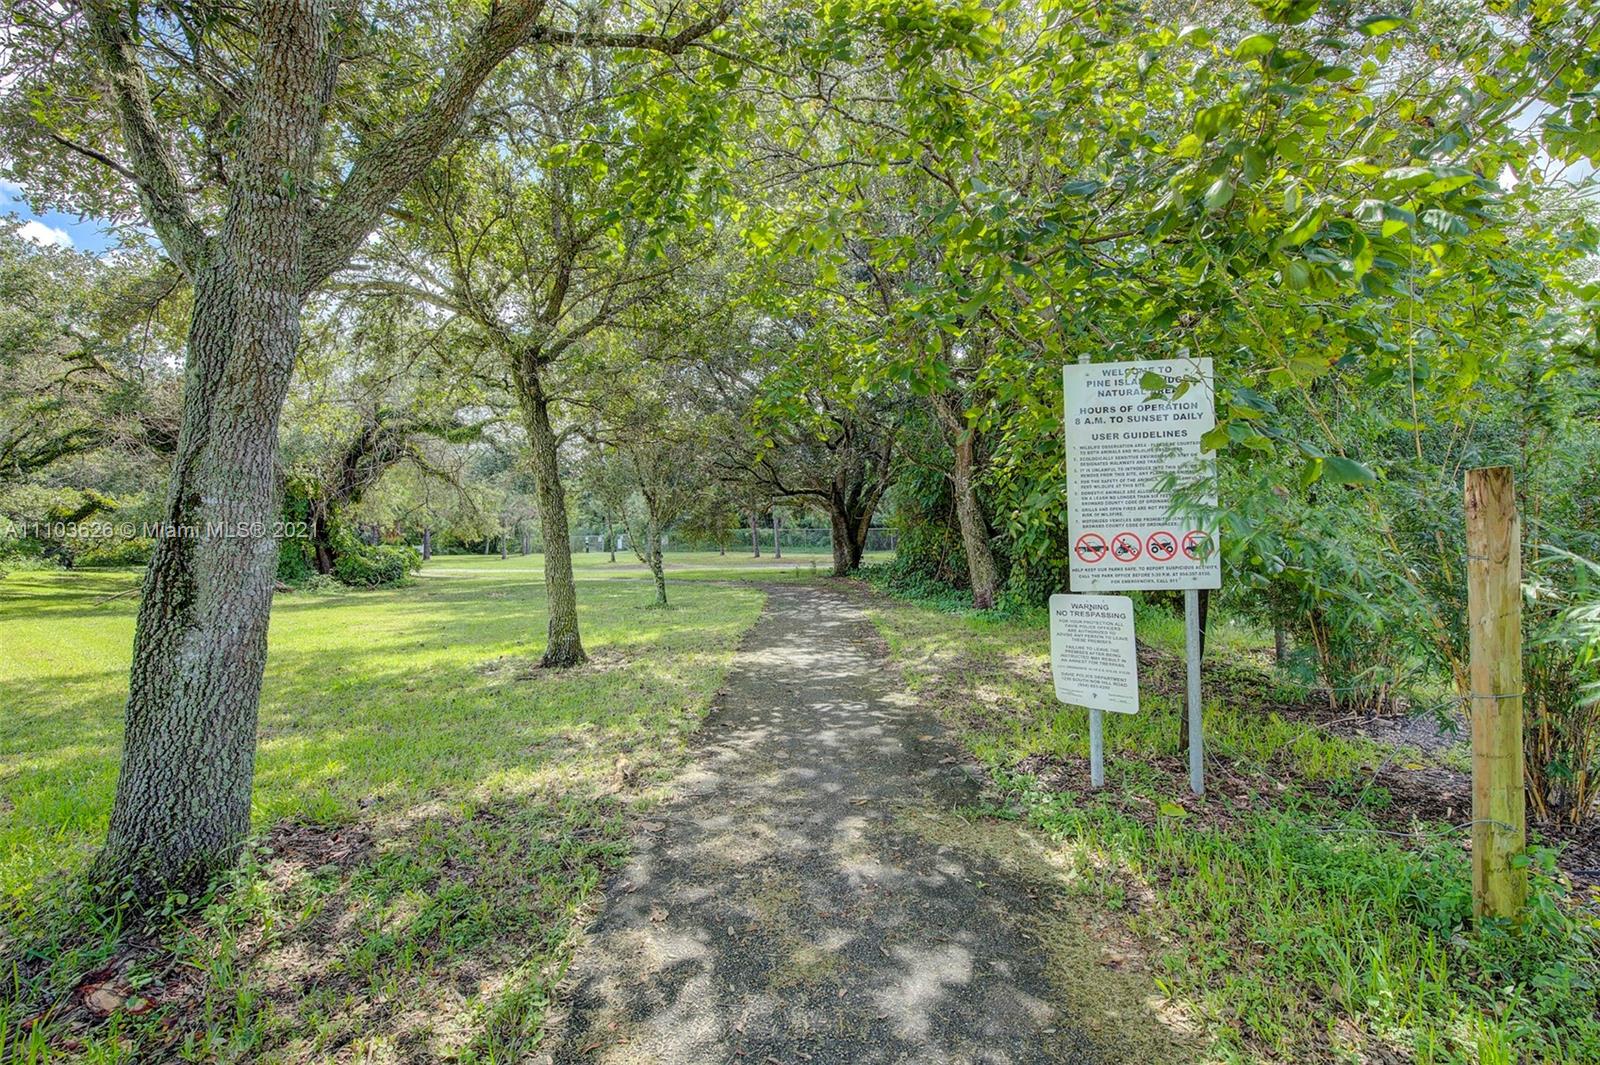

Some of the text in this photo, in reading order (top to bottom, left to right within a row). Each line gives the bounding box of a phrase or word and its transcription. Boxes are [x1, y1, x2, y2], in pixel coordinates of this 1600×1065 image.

[1086, 379, 1111, 388] PINE
[1098, 389, 1146, 398] NATURAL
[1080, 406, 1116, 415] HOURS
[1136, 402, 1198, 412] OPERATION
[1084, 416, 1106, 425] A.M.
[1127, 414, 1170, 423] SUNSET
[1173, 412, 1204, 421] DAILY
[1092, 430, 1188, 440] USER GUIDELINES
[1071, 603, 1110, 611] WARNING
[1070, 611, 1126, 620] TRESPASSING
